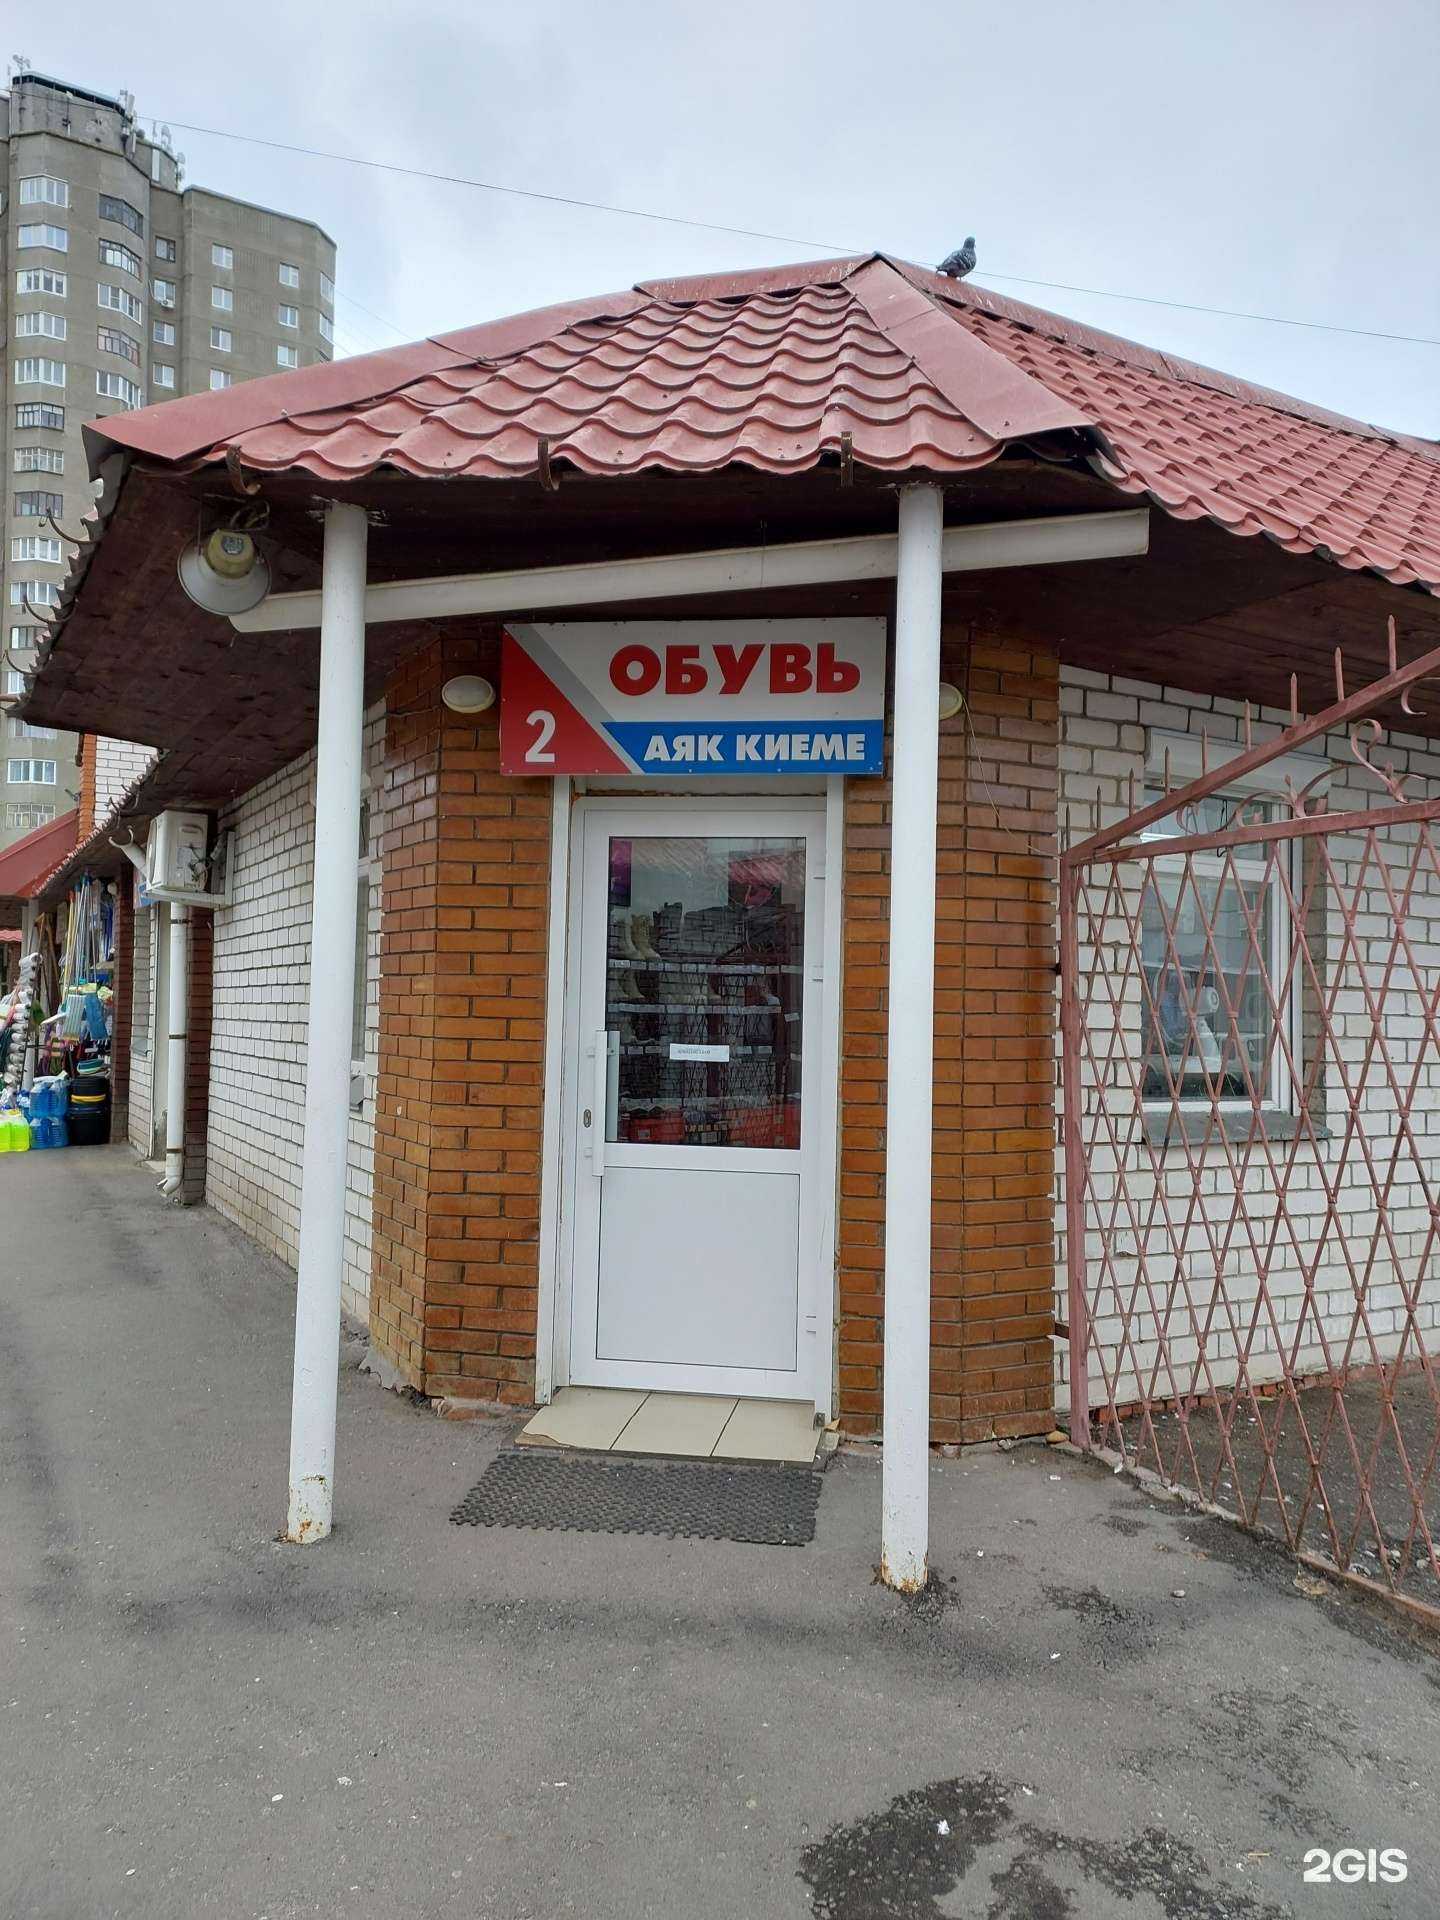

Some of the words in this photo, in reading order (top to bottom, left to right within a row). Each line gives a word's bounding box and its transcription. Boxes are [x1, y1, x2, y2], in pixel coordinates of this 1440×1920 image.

[609, 642, 861, 697] ОБУВЬ
[525, 709, 556, 763] 2
[643, 733, 724, 761] АЯК
[735, 733, 865, 761] КИЕМЕ
